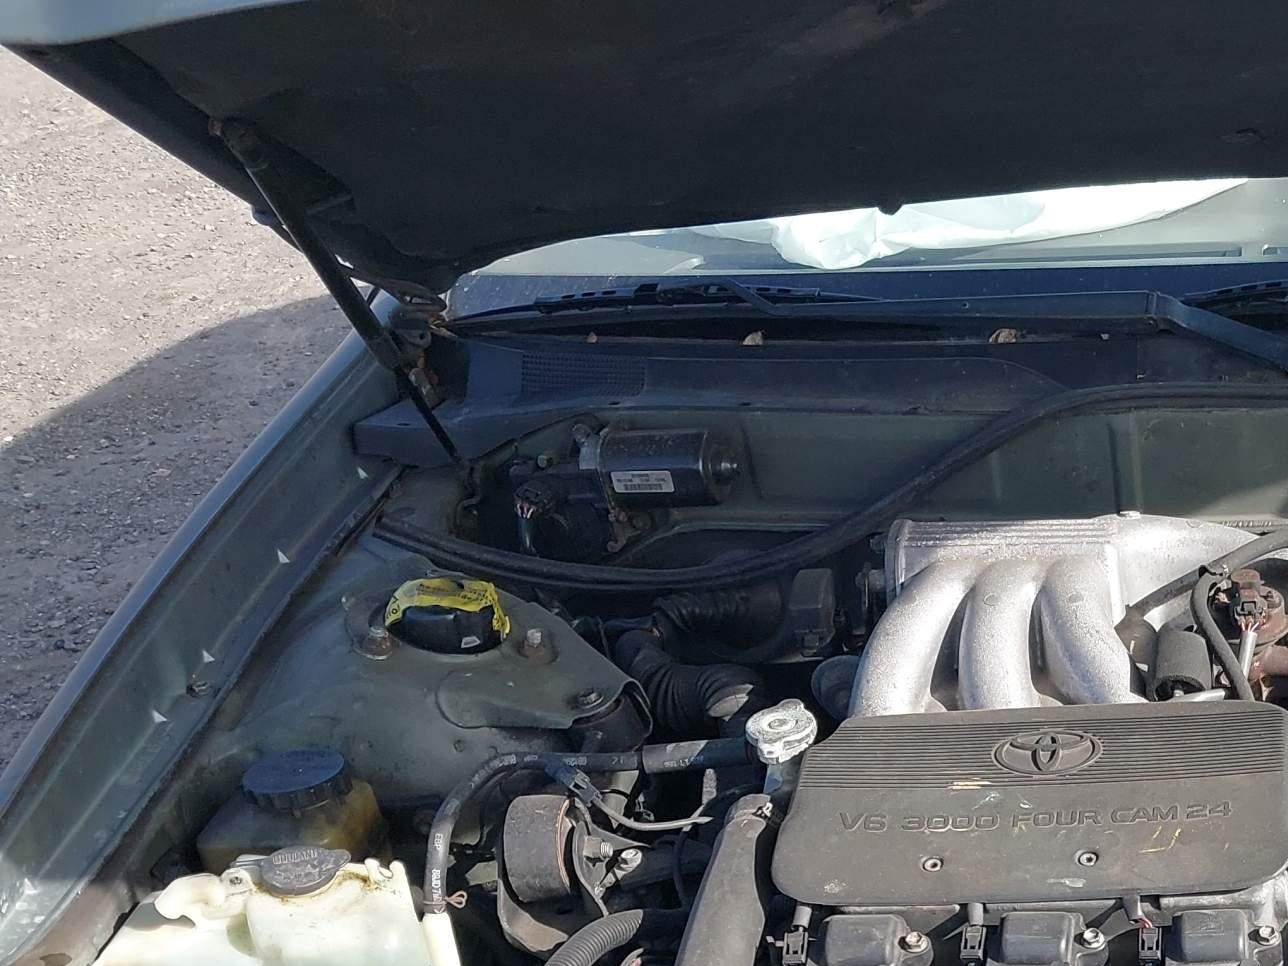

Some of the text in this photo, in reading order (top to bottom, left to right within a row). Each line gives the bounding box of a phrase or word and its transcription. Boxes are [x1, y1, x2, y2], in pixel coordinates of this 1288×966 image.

[839, 800, 1233, 832] V6 3000 FOUR CAM 24
